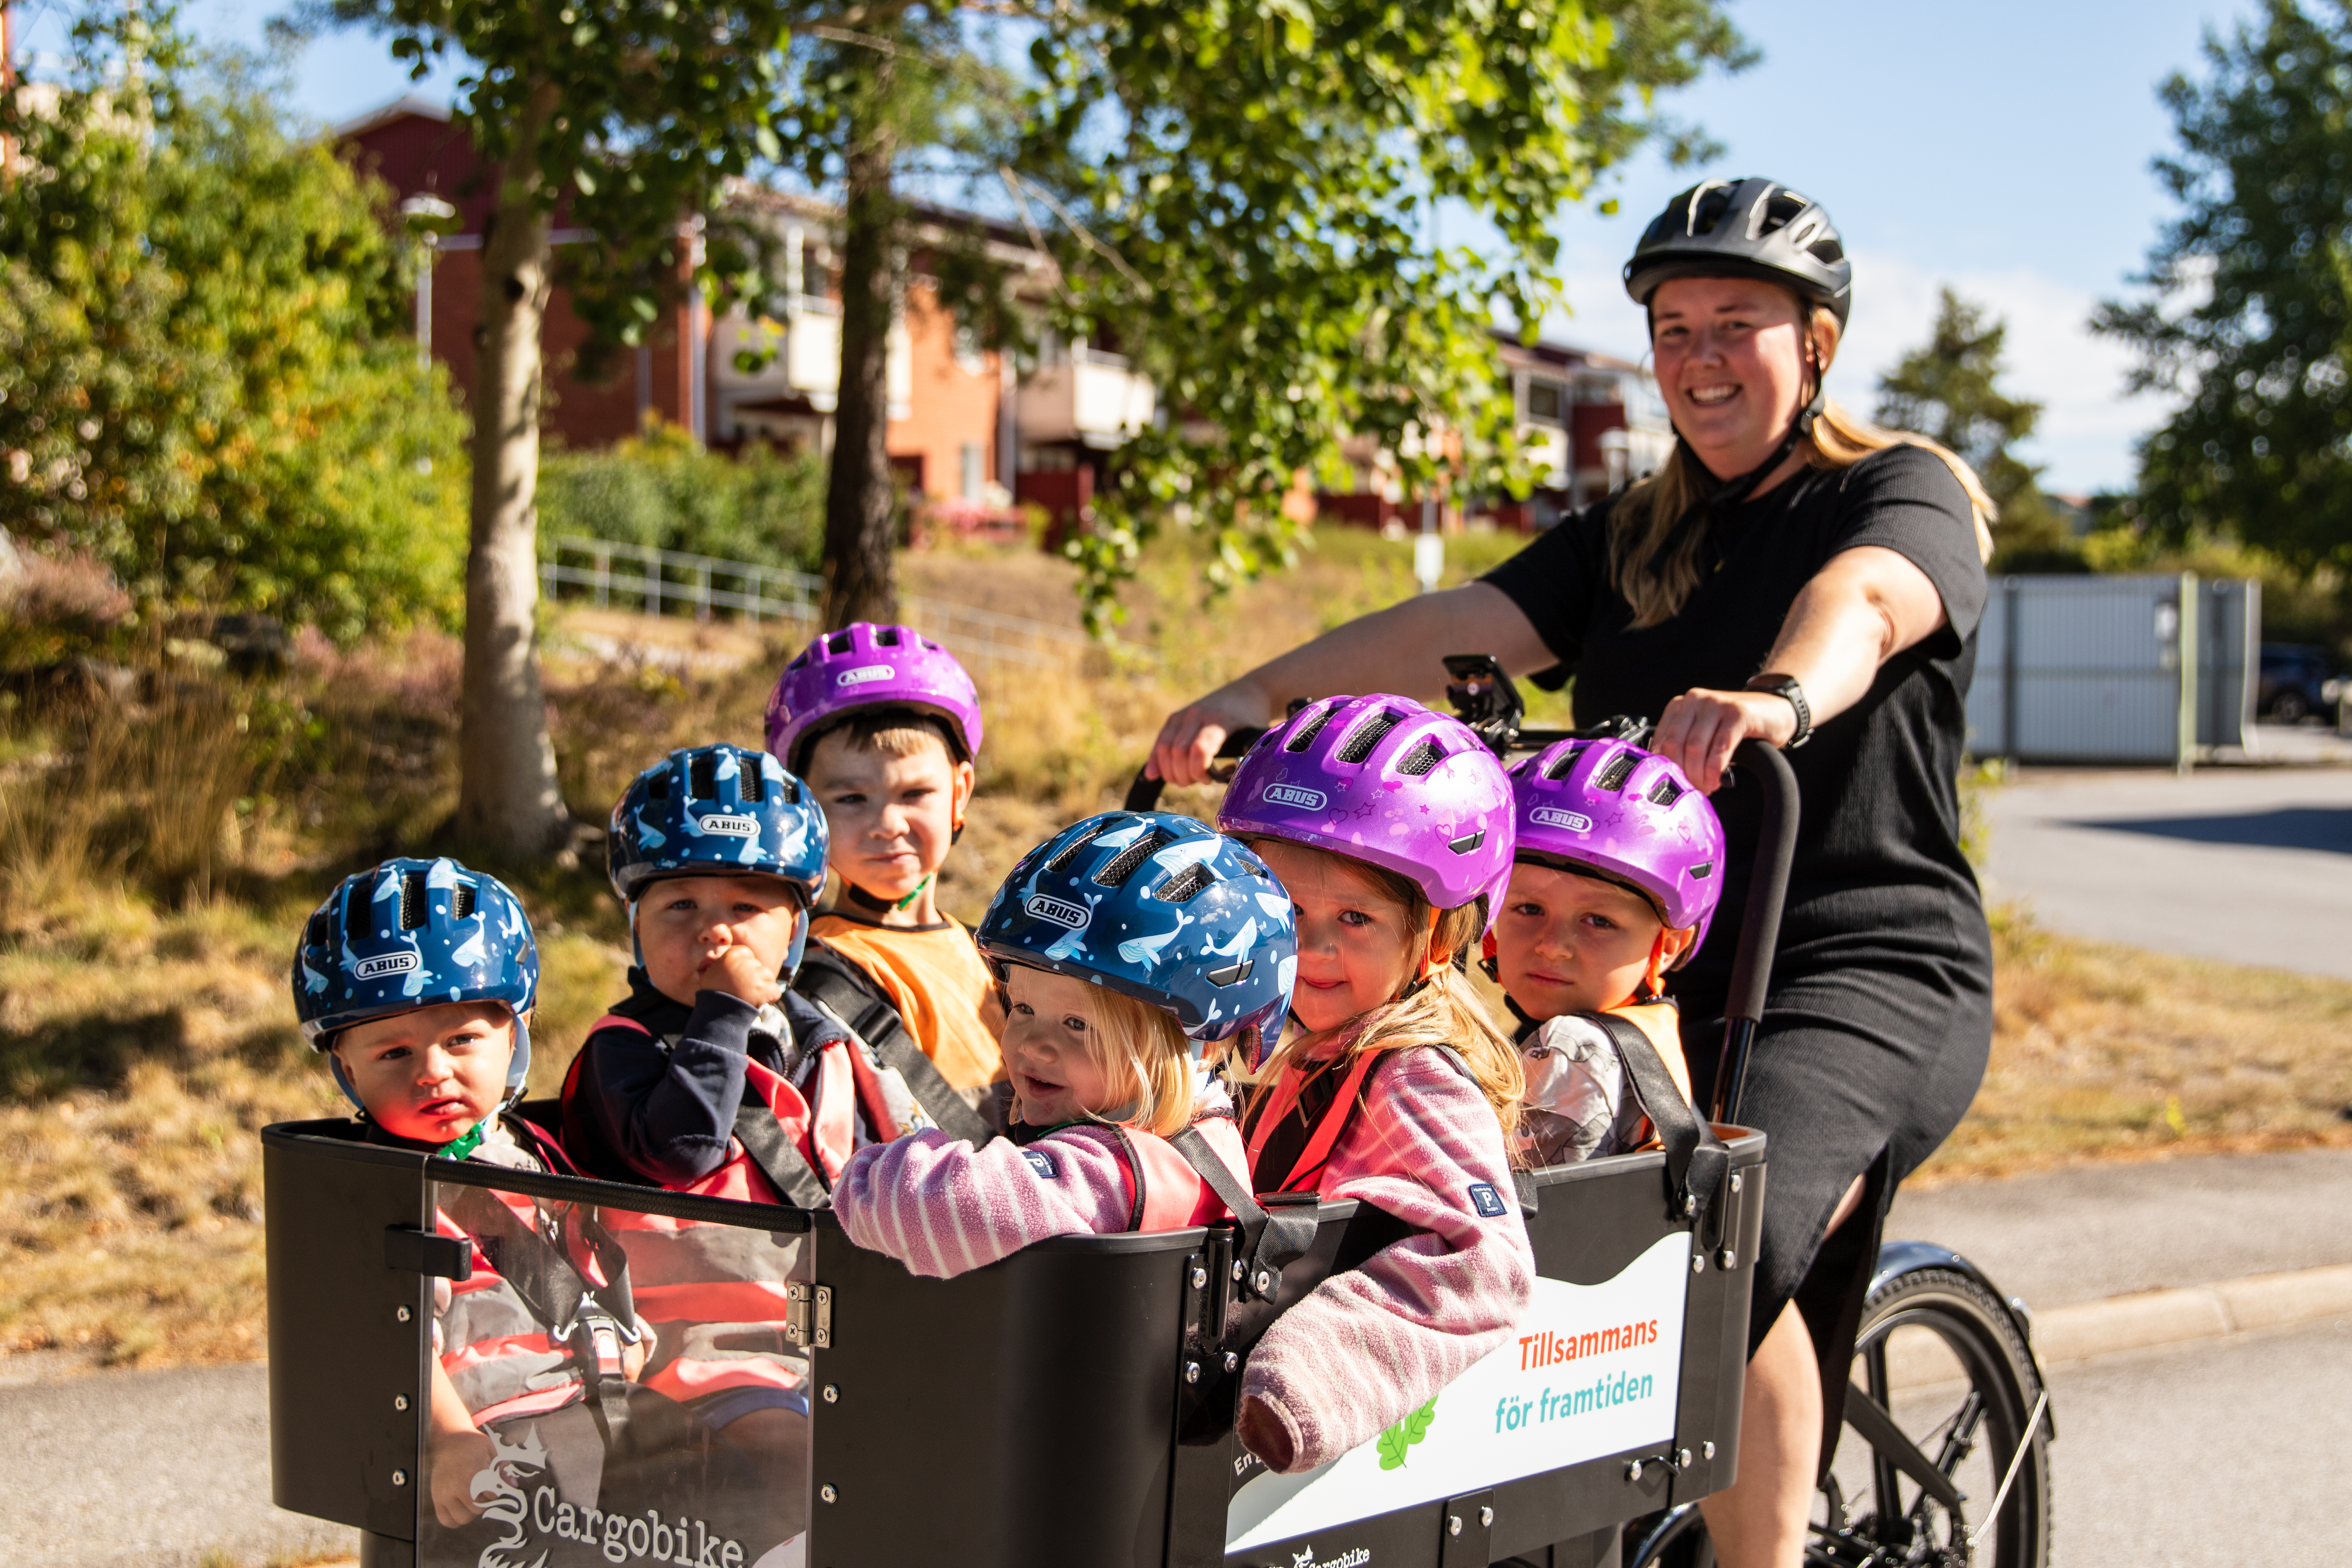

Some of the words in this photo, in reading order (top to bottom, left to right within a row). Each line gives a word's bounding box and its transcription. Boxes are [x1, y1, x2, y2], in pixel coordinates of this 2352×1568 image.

[1269, 787, 1319, 806] ABUS
[709, 820, 750, 831] ABUS
[1536, 810, 1585, 828] ABUS
[1032, 900, 1081, 924] ABUS
[363, 957, 409, 974] ABUS
[1482, 1191, 1492, 1207] P
[1519, 1319, 1657, 1371] Tillsammans
[1496, 1395, 1533, 1433] för
[1540, 1371, 1652, 1423] framtiden
[1234, 1453, 1252, 1476] En
[534, 1485, 744, 1568] Cargobike
